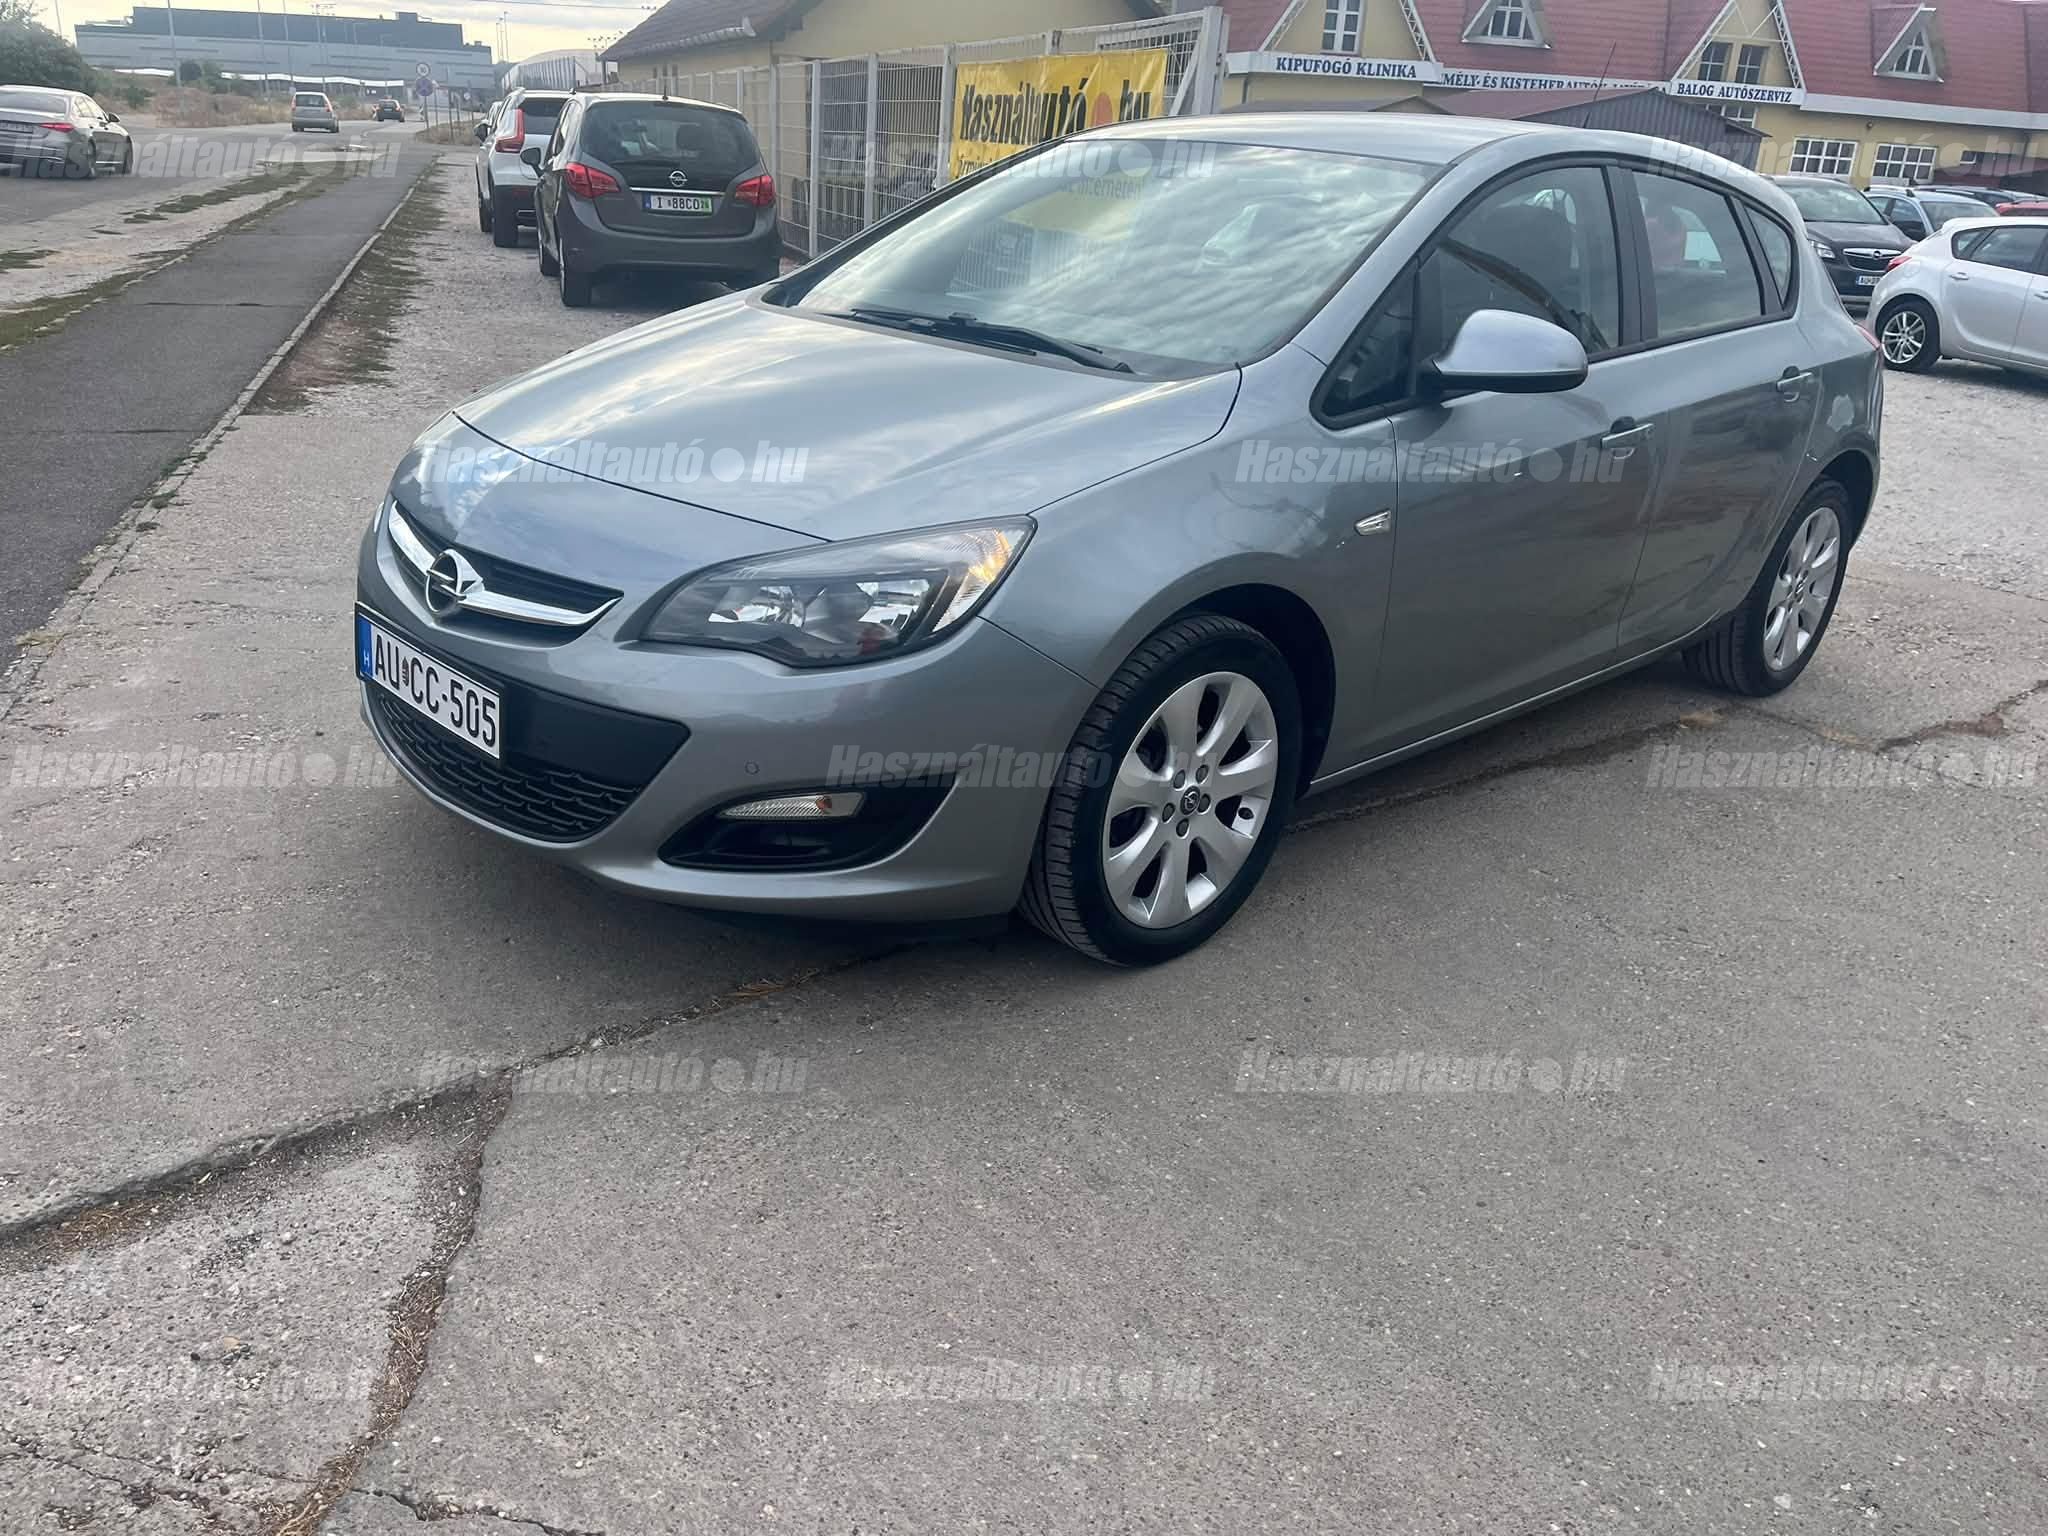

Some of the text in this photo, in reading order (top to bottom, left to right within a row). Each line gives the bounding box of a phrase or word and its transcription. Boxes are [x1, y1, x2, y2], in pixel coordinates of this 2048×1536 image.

[1275, 56, 1417, 78] KIPUFOGÓ KLINIKA
[1482, 72, 1499, 89] ÉS
[1676, 82, 1714, 97] BALOG
